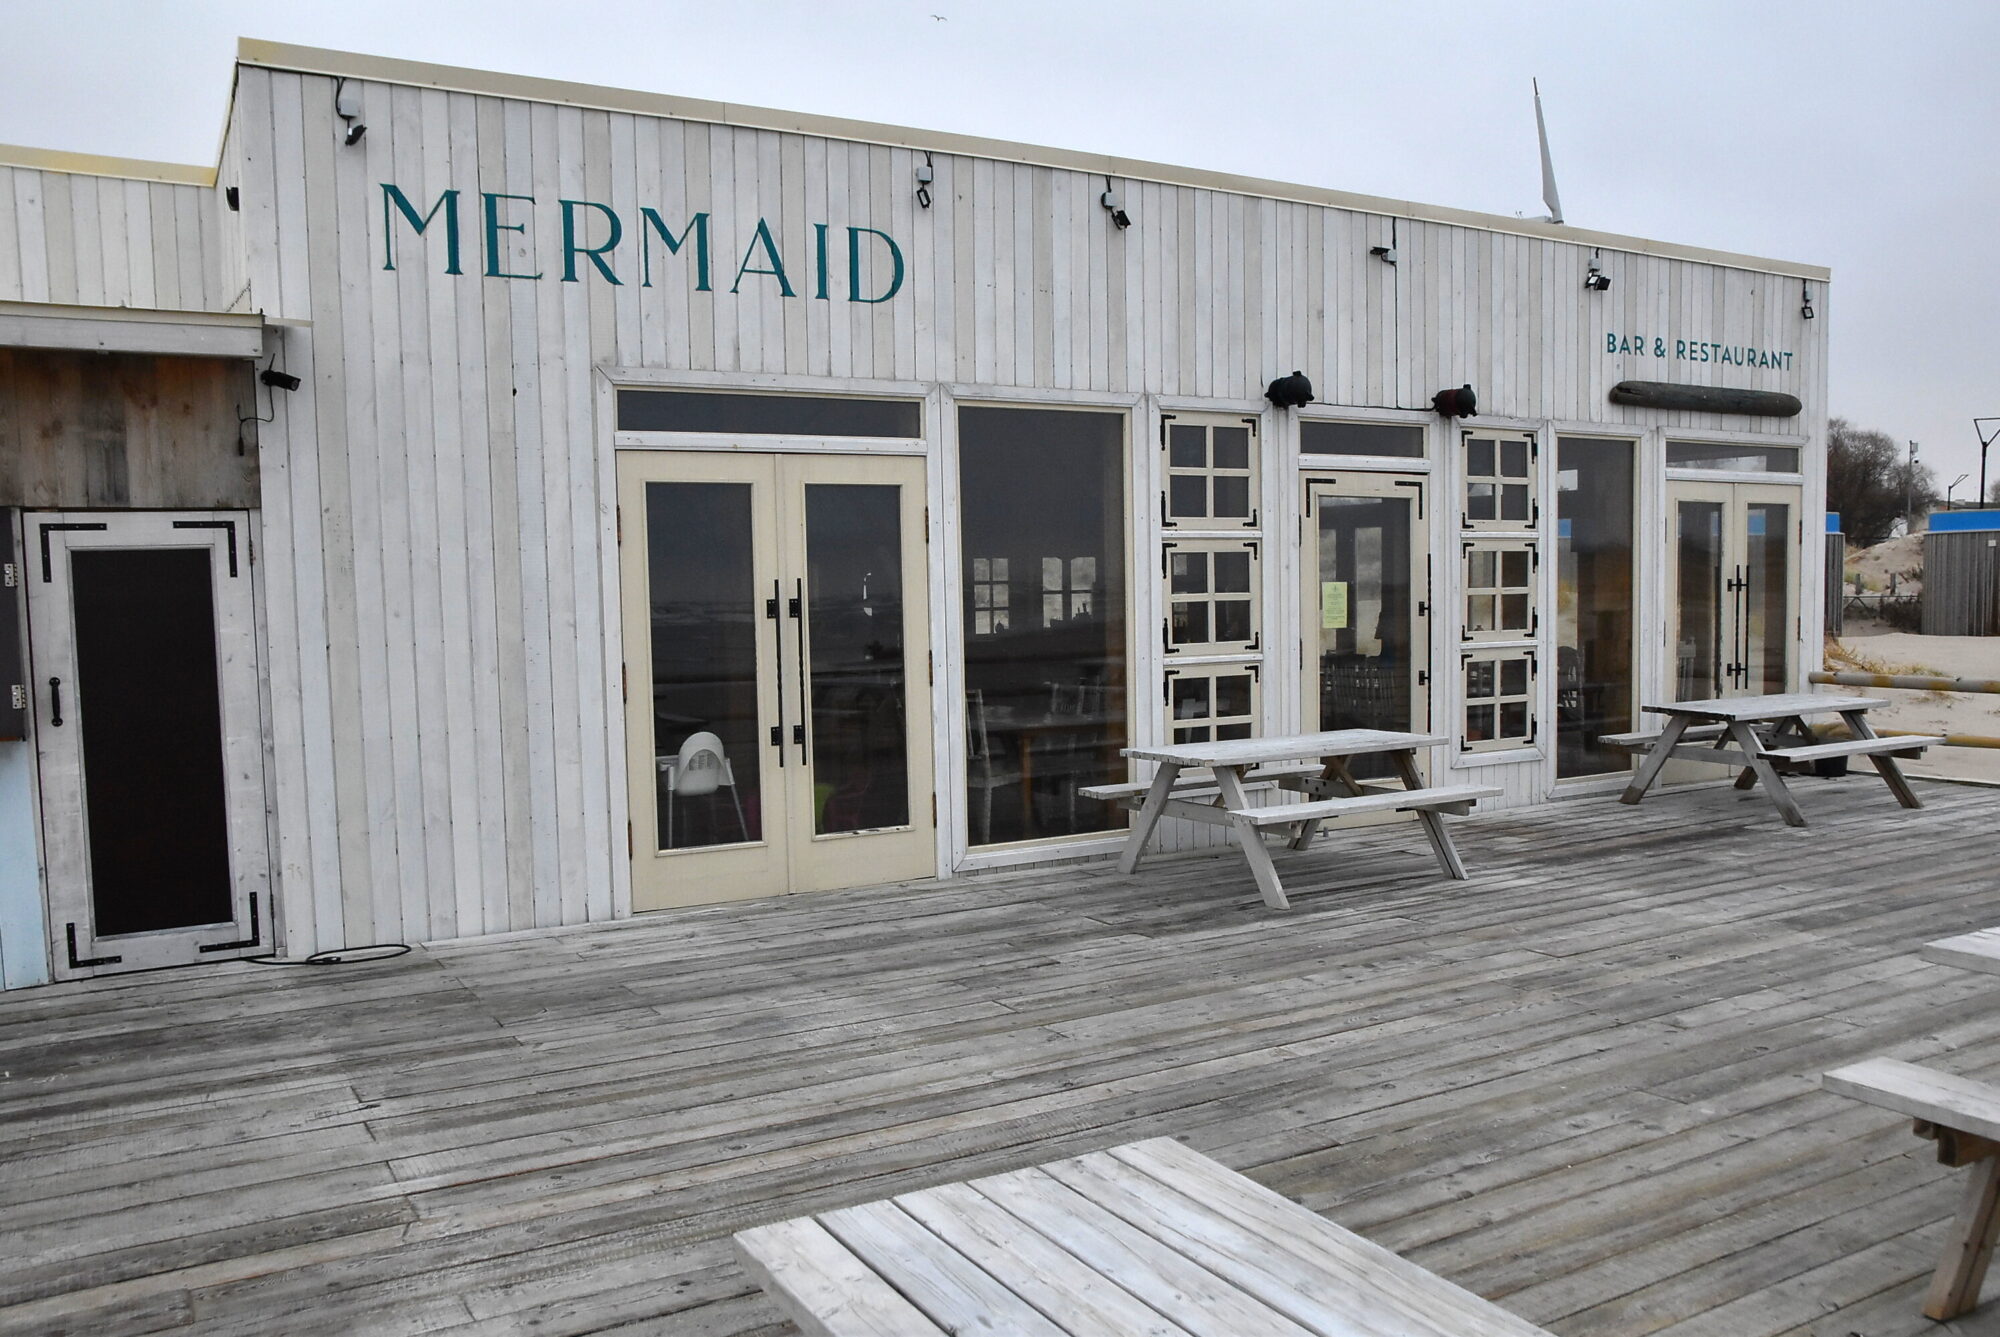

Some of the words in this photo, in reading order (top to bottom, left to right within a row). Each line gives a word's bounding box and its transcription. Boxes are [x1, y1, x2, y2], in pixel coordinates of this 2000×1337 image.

[380, 183, 905, 304] MERMAID
[1606, 332, 1645, 356] BAR
[1653, 337, 1666, 359] &
[1676, 339, 1793, 371] RESTAURANT
